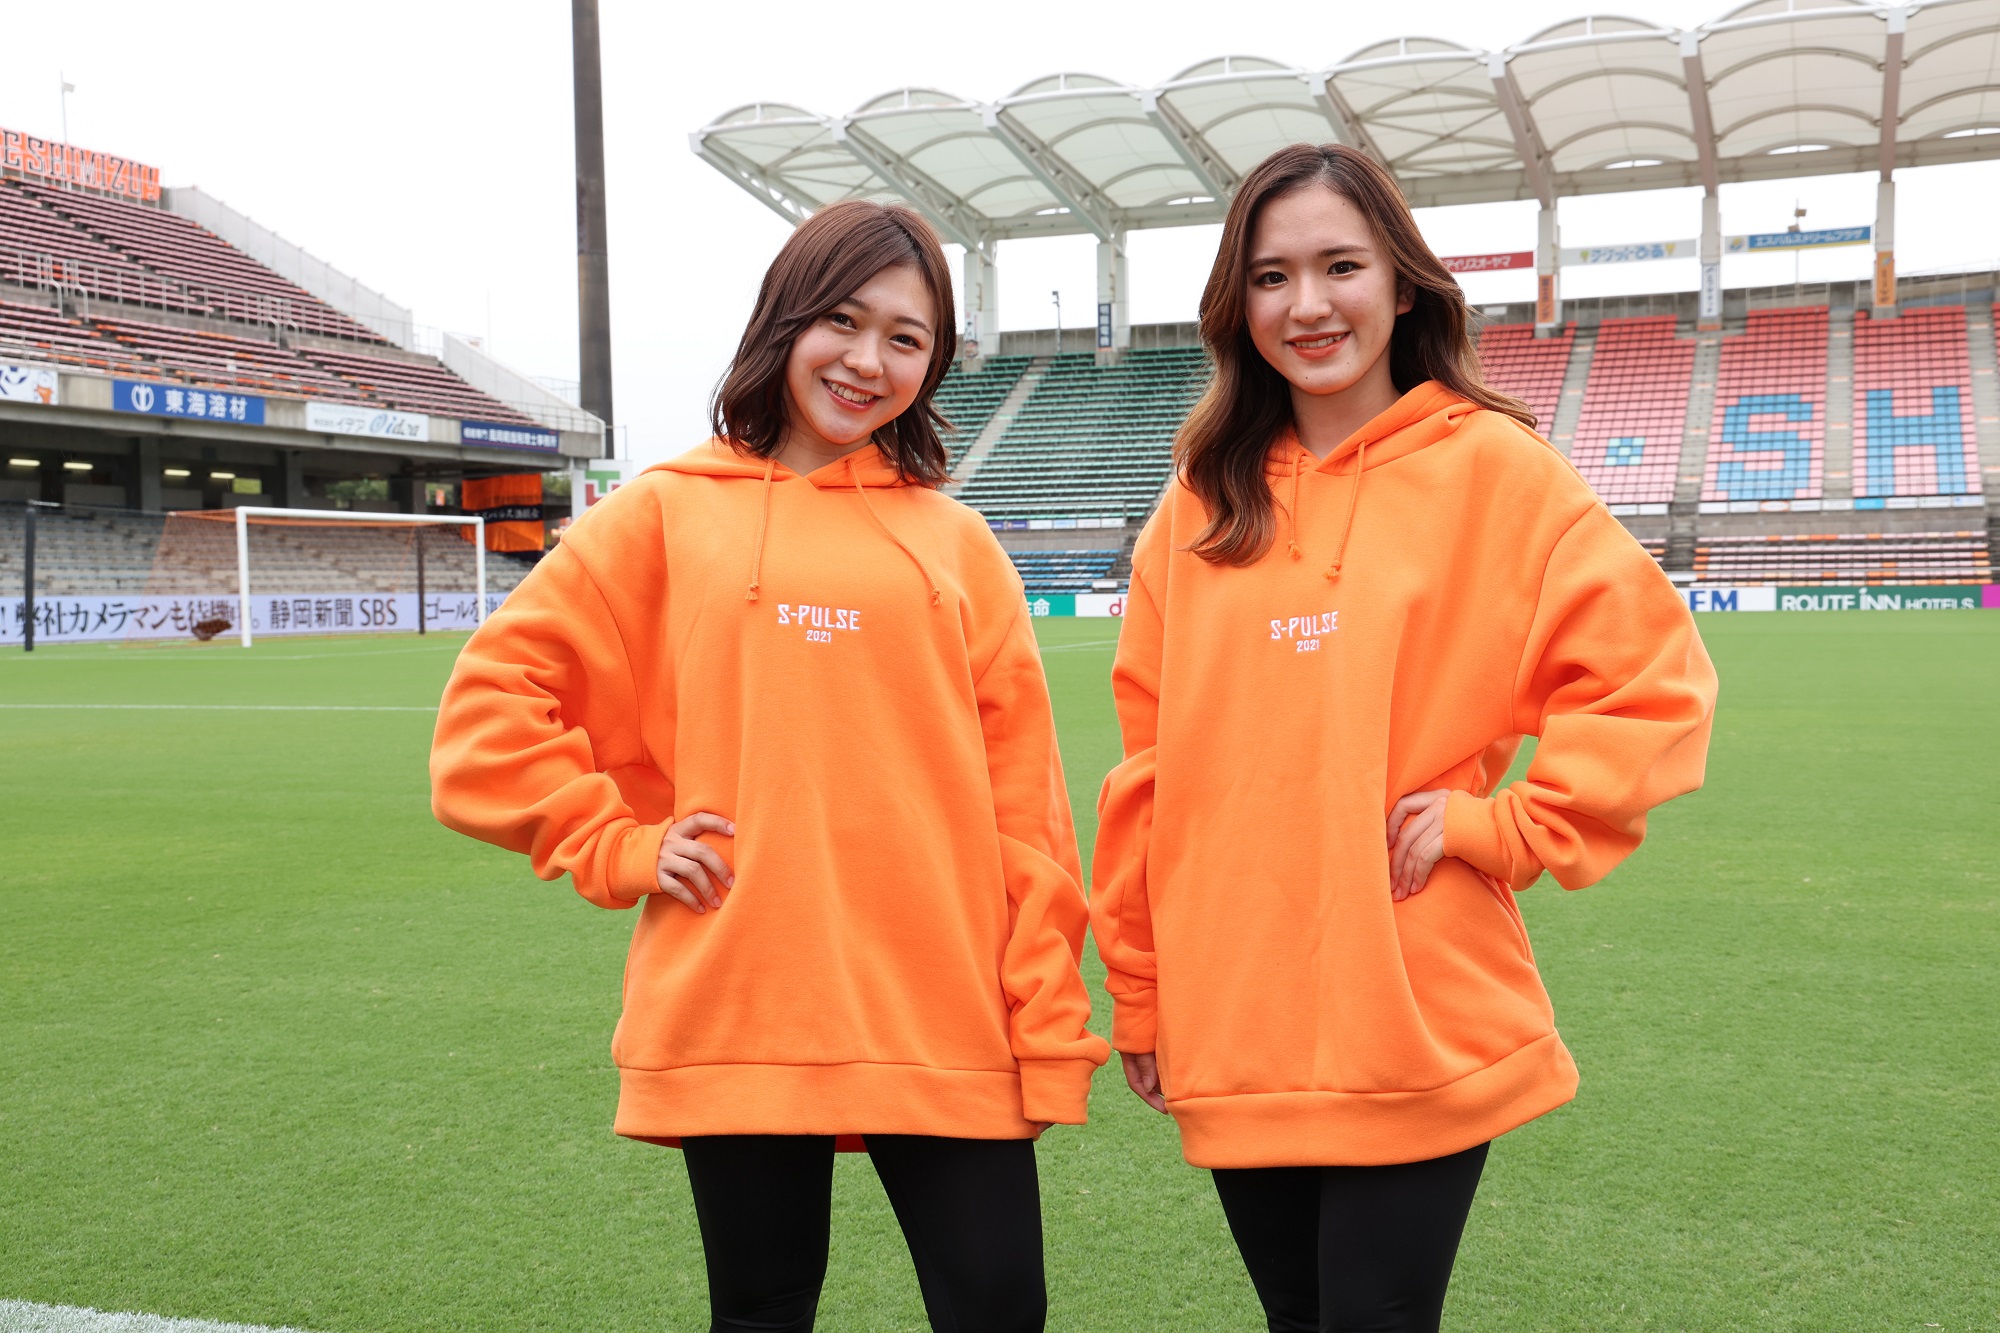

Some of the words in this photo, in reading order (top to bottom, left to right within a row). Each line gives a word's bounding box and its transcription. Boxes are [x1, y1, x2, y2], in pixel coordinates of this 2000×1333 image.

[165, 389, 248, 420] 東海溶材
[1781, 595, 1855, 611] ROUTE
[778, 604, 861, 630] S-PULSE
[1270, 611, 1339, 639] S-PULSE
[806, 629, 831, 643] 2021
[1296, 639, 1320, 653] 2021
